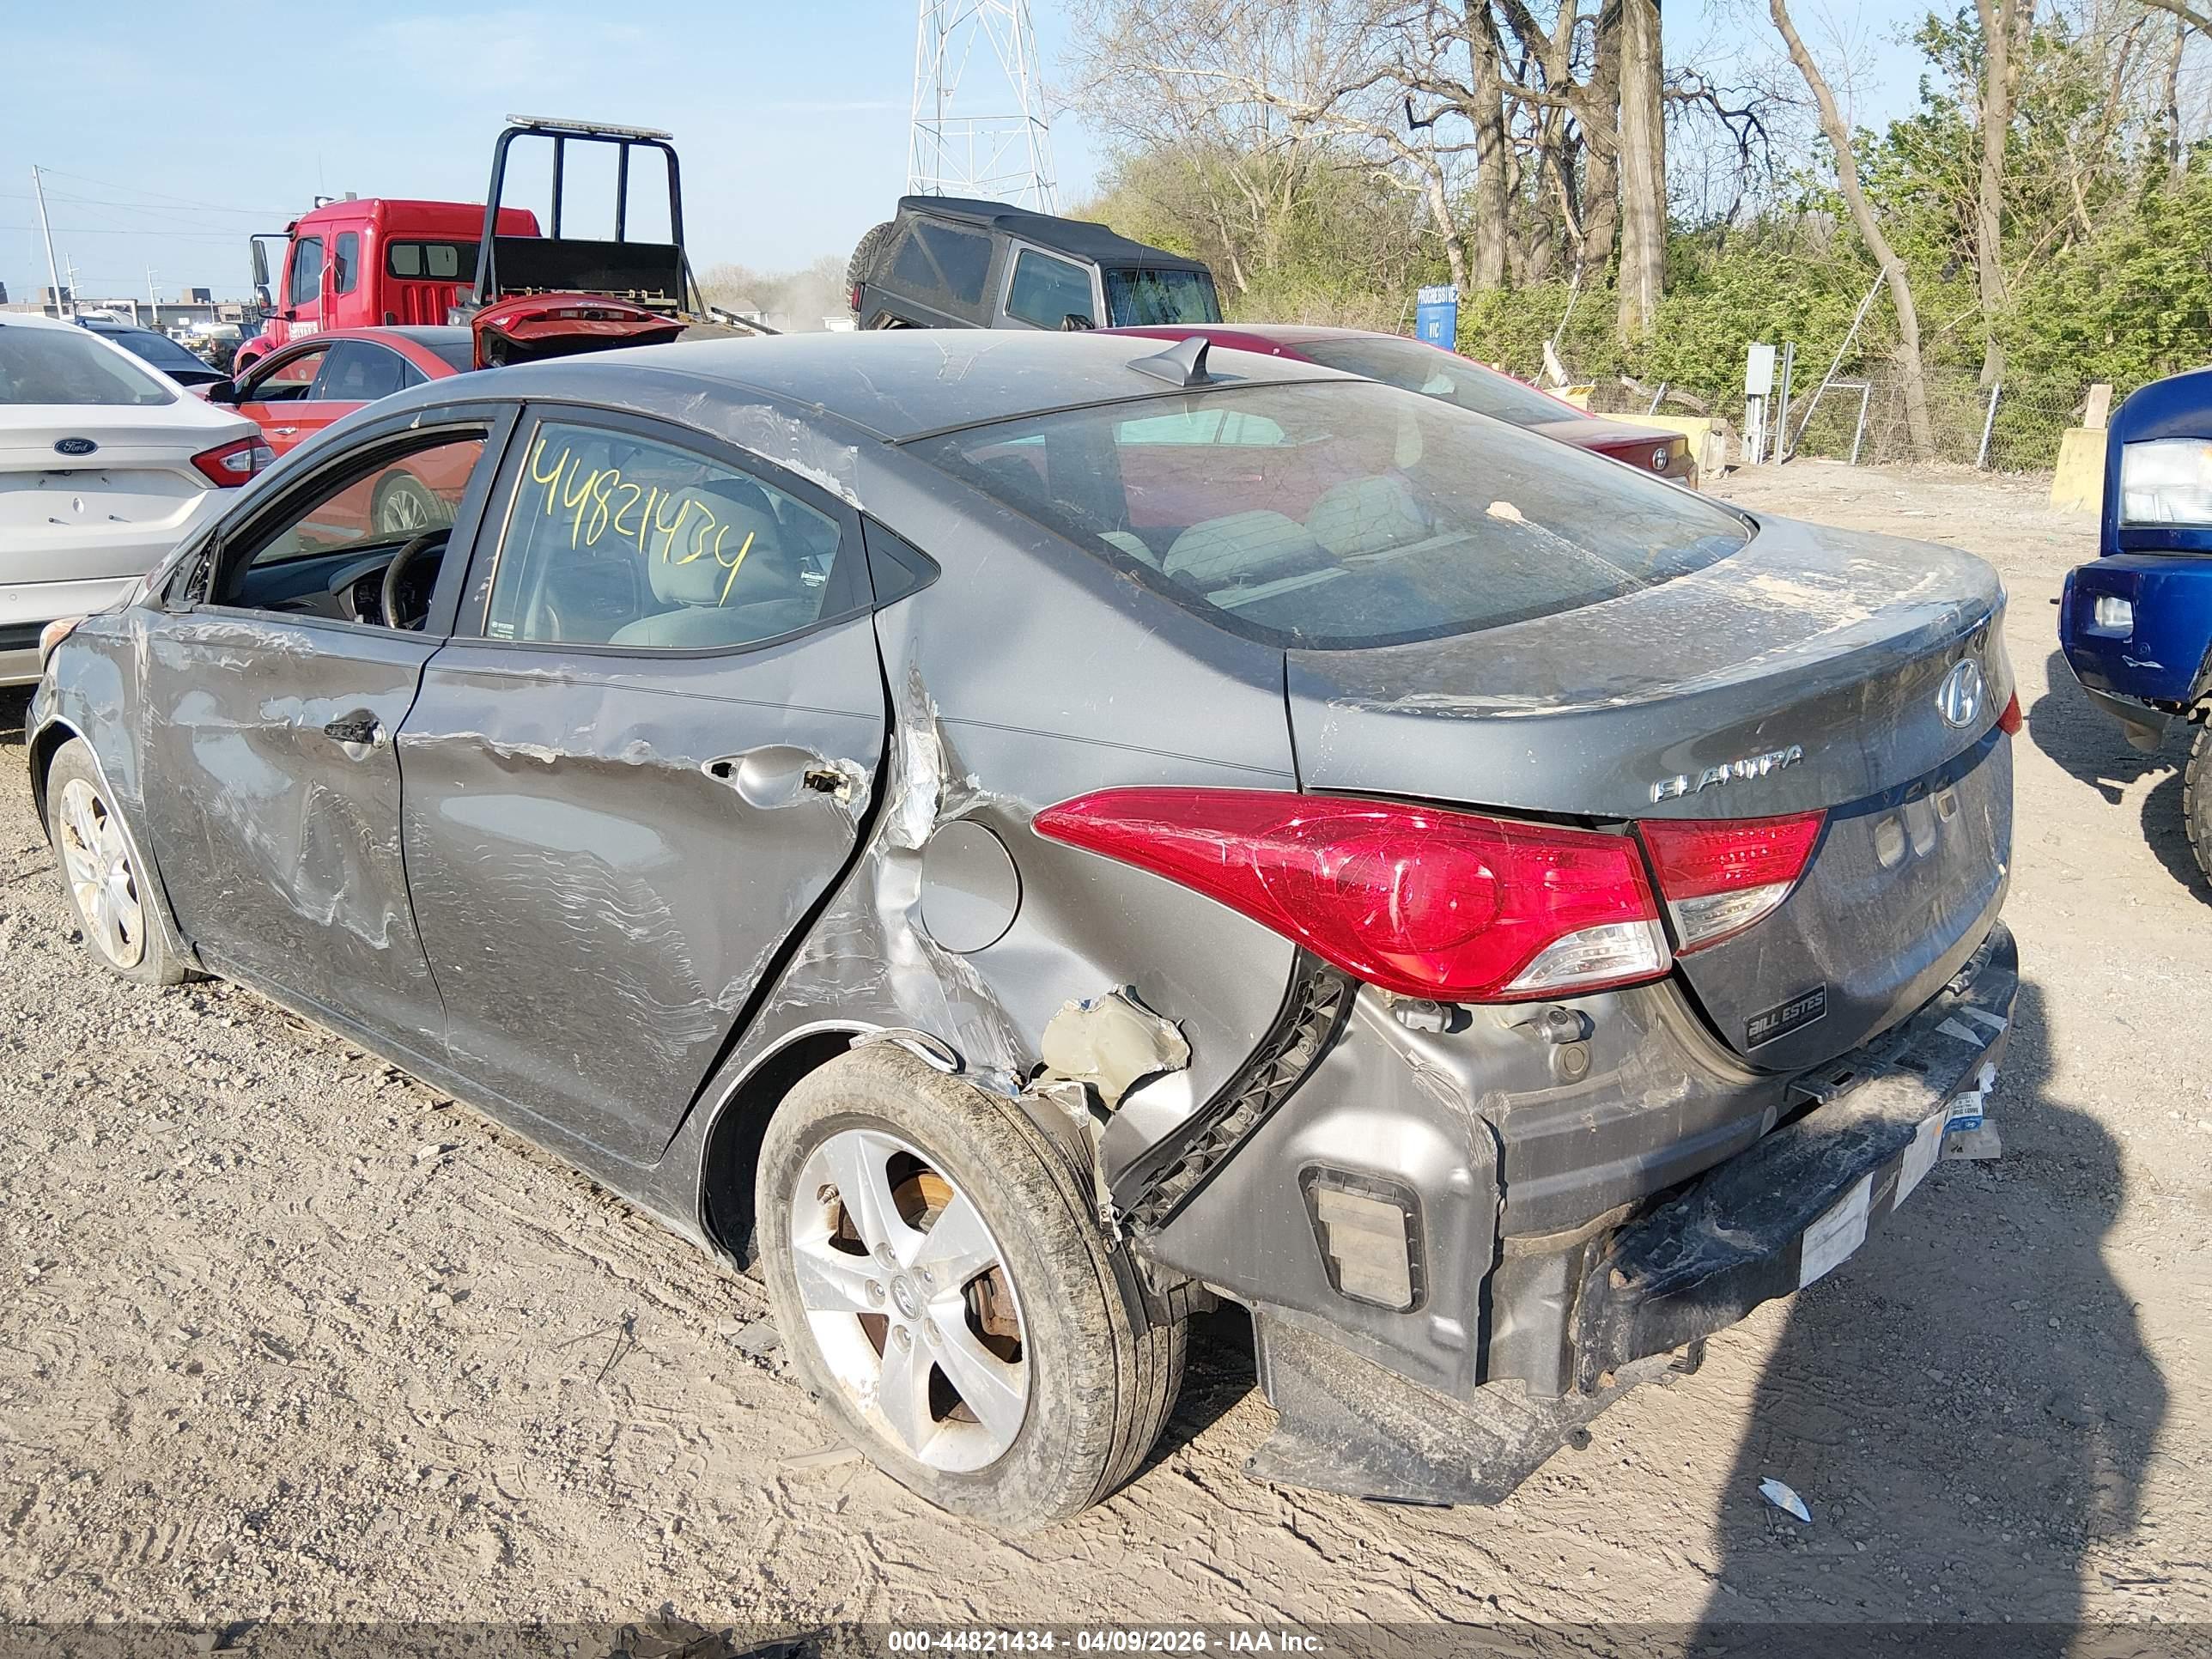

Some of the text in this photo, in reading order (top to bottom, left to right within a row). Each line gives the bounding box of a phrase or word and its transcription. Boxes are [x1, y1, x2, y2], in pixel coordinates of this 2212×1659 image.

[1417, 286, 1456, 304] PROGRESSIVE
[1429, 322, 1440, 338] VIC
[63, 441, 88, 452] Ford
[532, 439, 755, 608] 44821434
[1748, 1013, 1779, 1037] BILL
[1782, 991, 1824, 1023] ESTES
